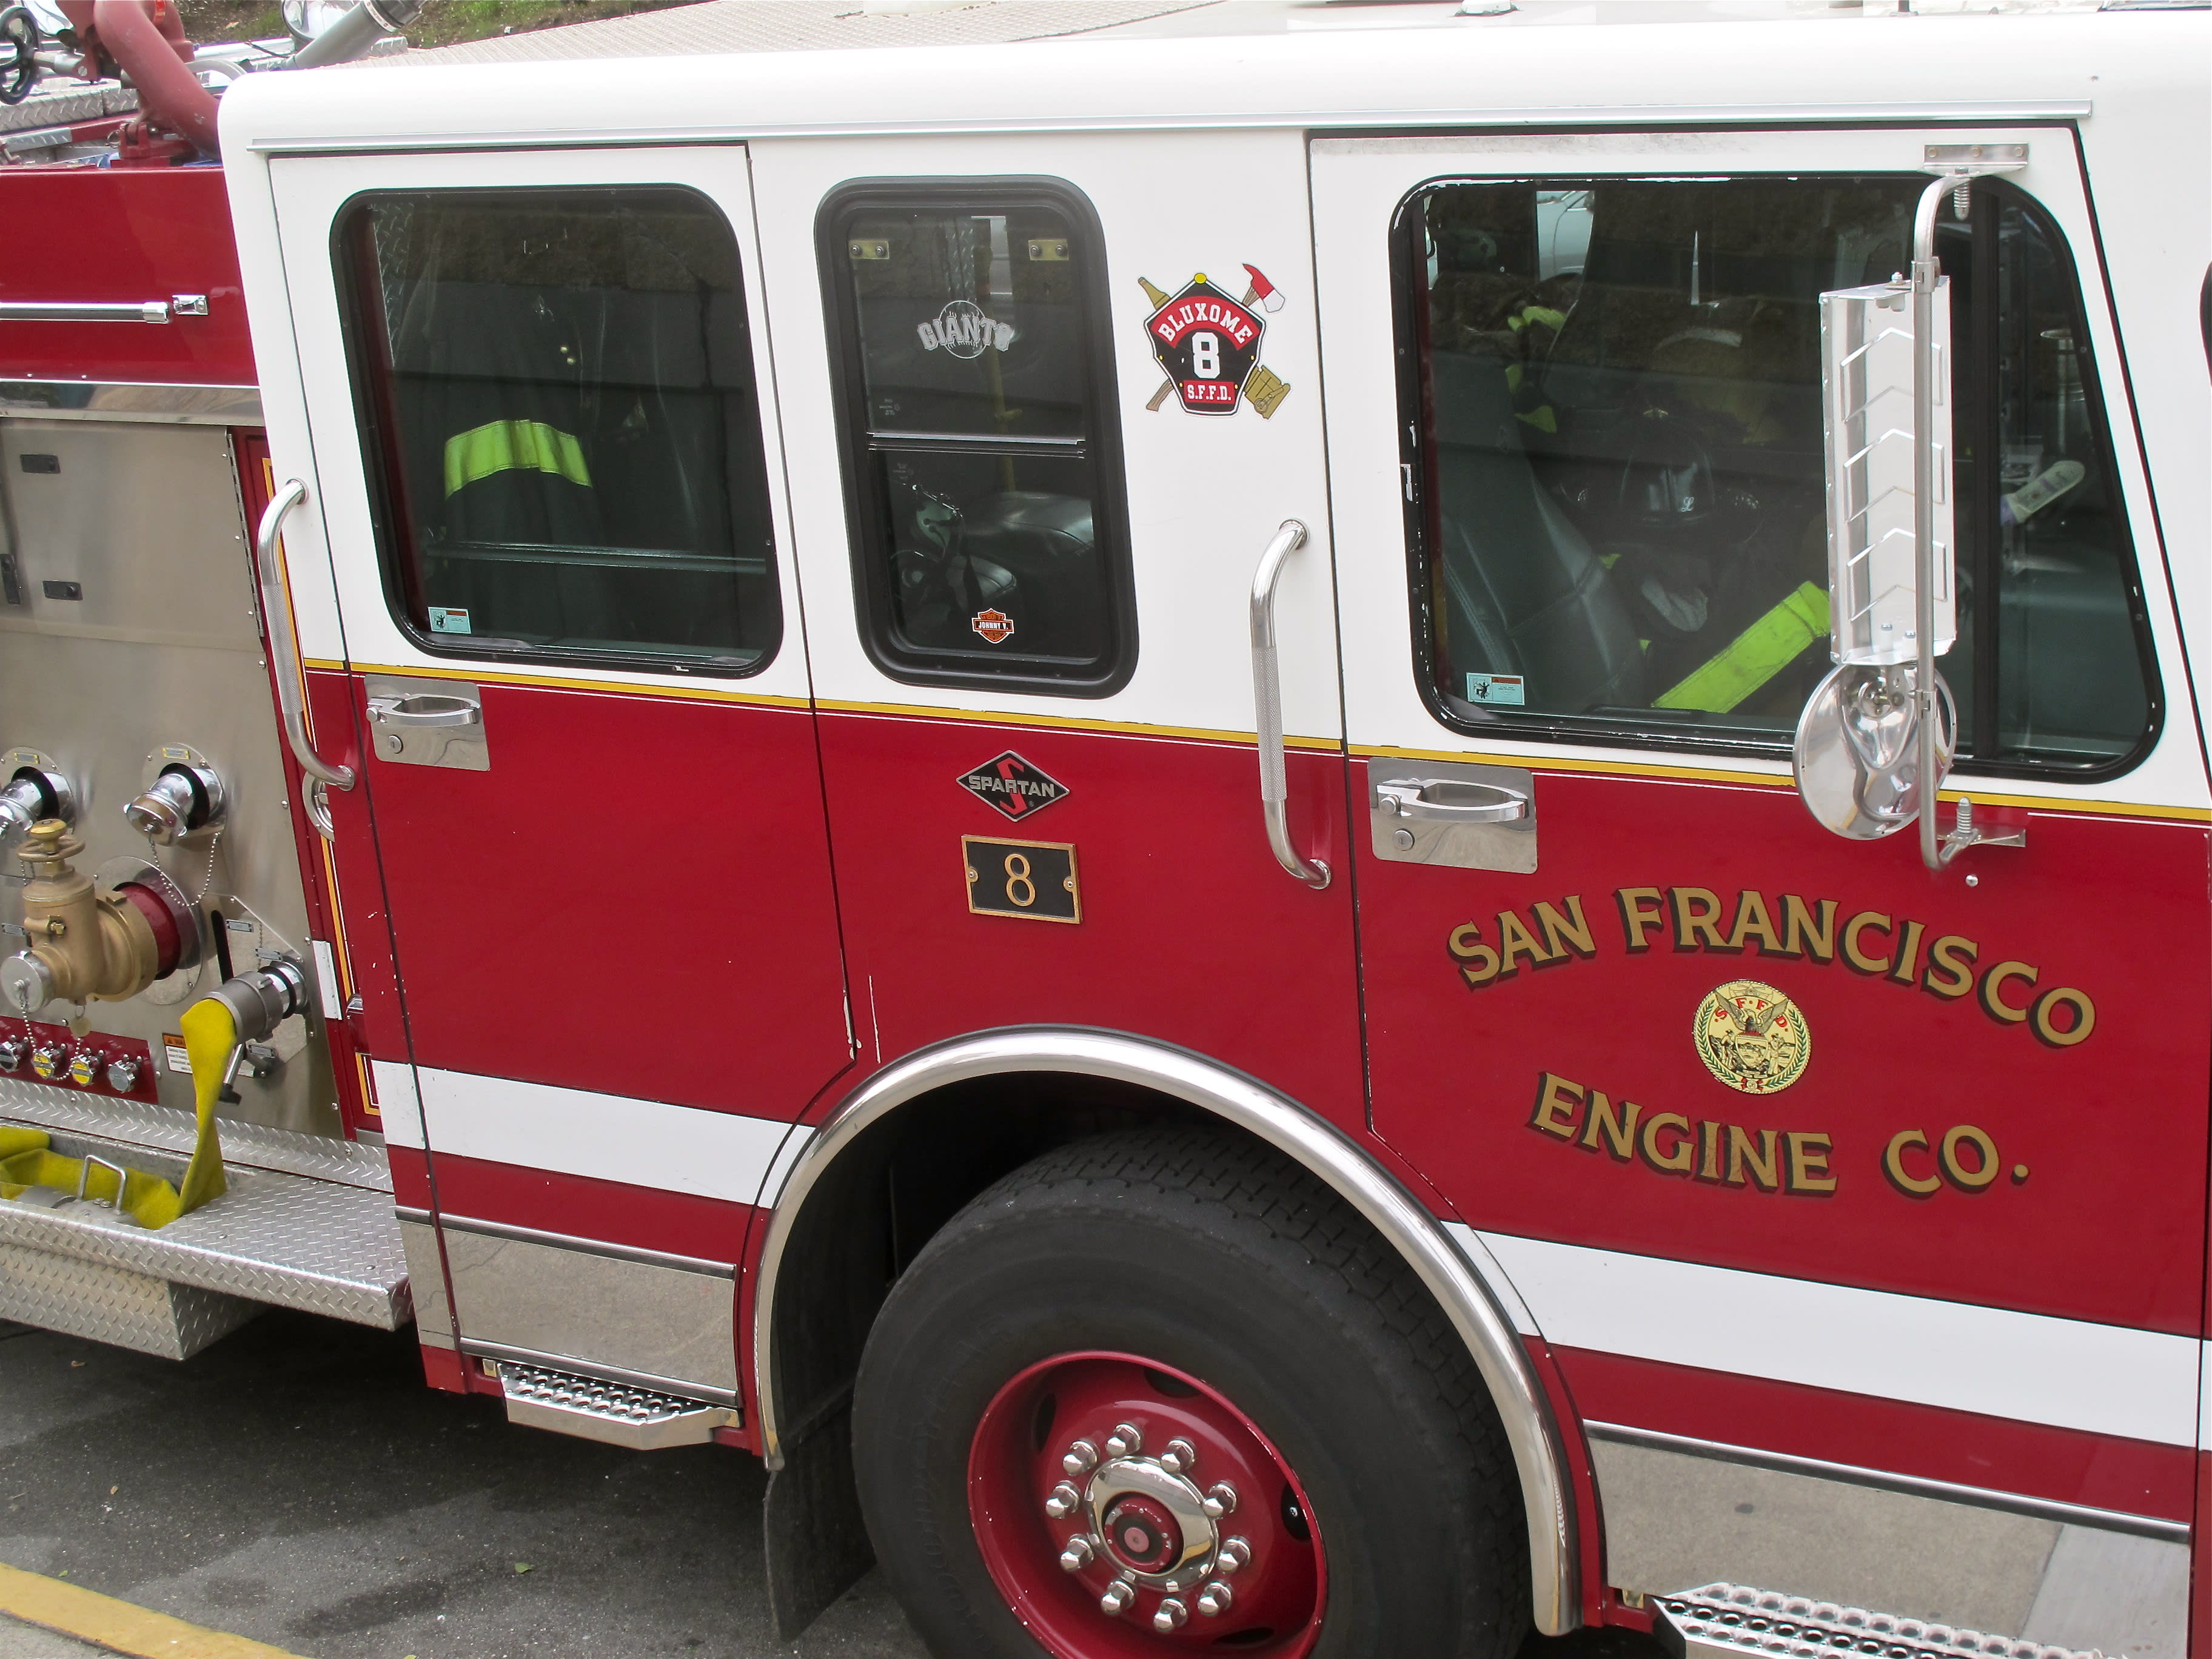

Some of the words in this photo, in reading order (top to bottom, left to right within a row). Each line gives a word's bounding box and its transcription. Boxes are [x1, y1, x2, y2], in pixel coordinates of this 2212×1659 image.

[1158, 302, 1253, 344] BLUXOME
[1191, 332, 1221, 380] 8
[1187, 384, 1232, 401] S.F.F.D.
[968, 775, 1056, 799] SPARTAN
[1004, 853, 1036, 907] 8
[1447, 894, 1597, 991] SAN
[1617, 886, 2096, 1047] FRANCISCO
[1531, 1071, 1838, 1193] ENGINE
[1880, 1124, 2030, 1195] CO.
